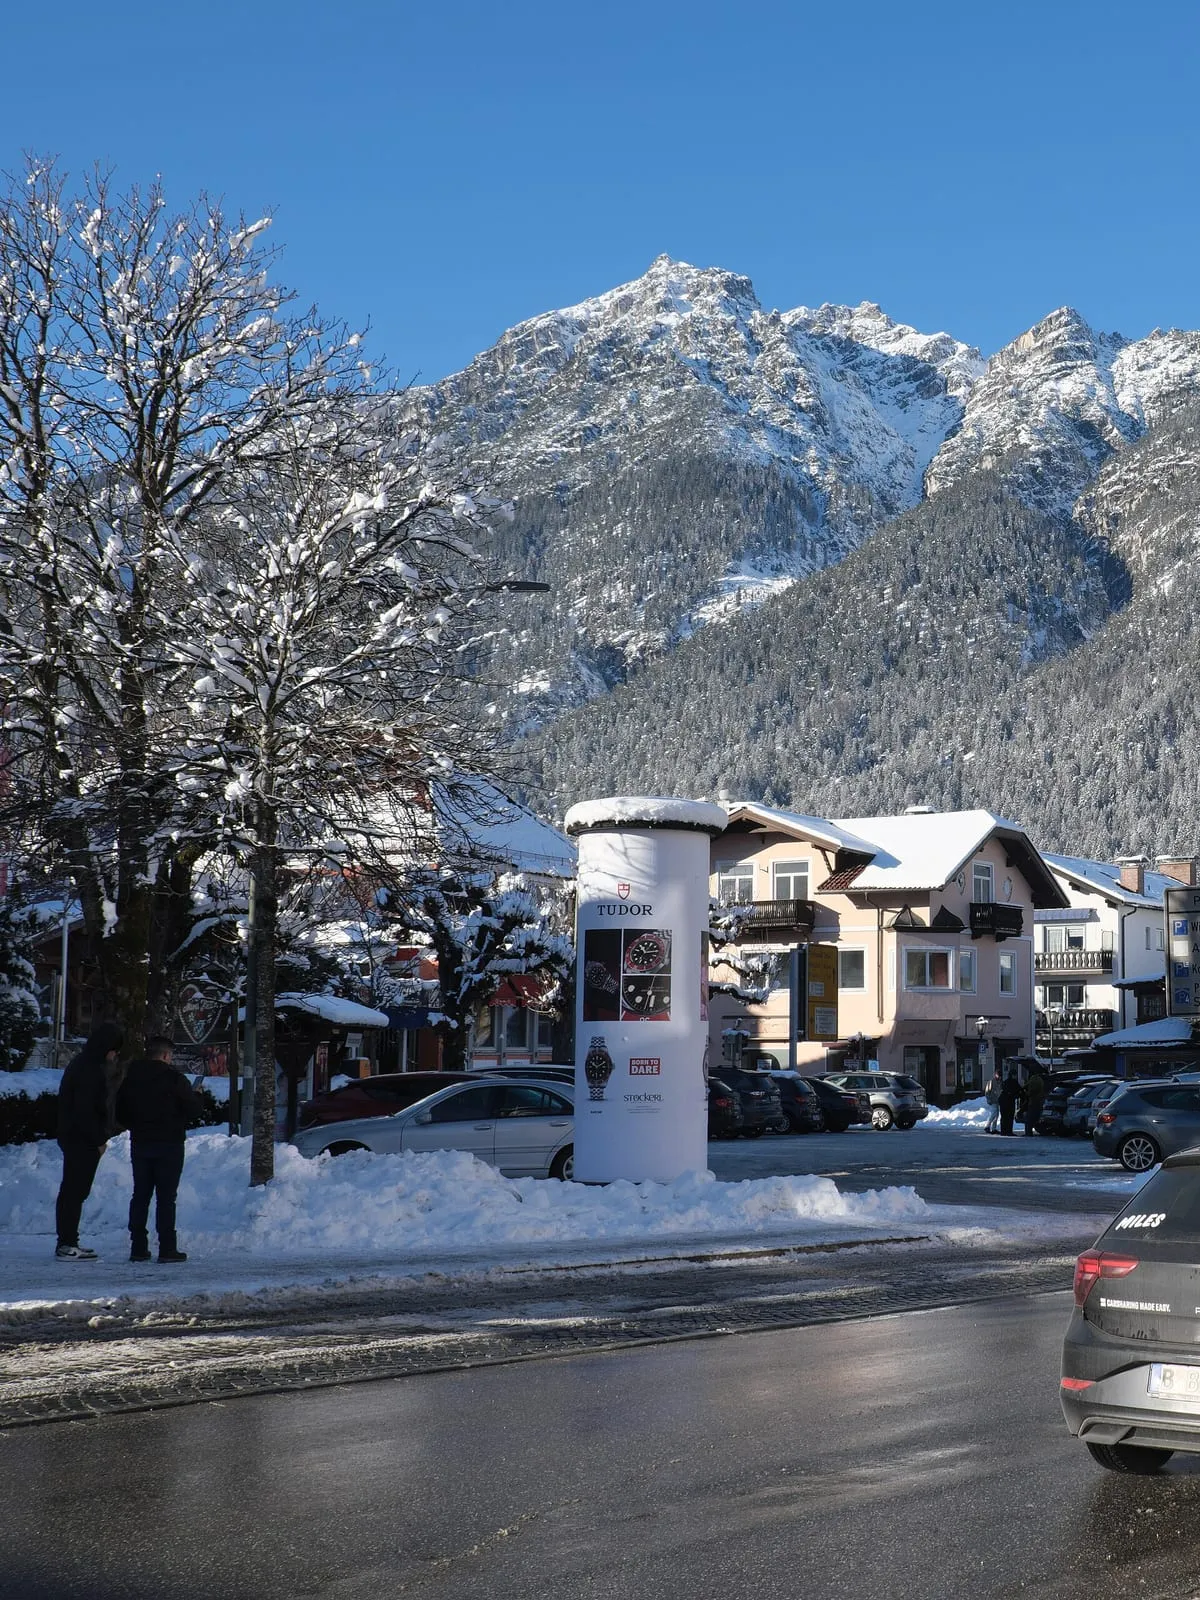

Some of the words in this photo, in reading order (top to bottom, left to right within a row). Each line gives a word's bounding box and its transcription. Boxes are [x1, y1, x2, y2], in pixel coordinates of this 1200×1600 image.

[597, 904, 654, 916] TUDOR
[631, 1065, 659, 1075] DARE
[1115, 1213, 1167, 1231] MILES
[1139, 1302, 1155, 1311] MADE
[1162, 1368, 1174, 1388] B
